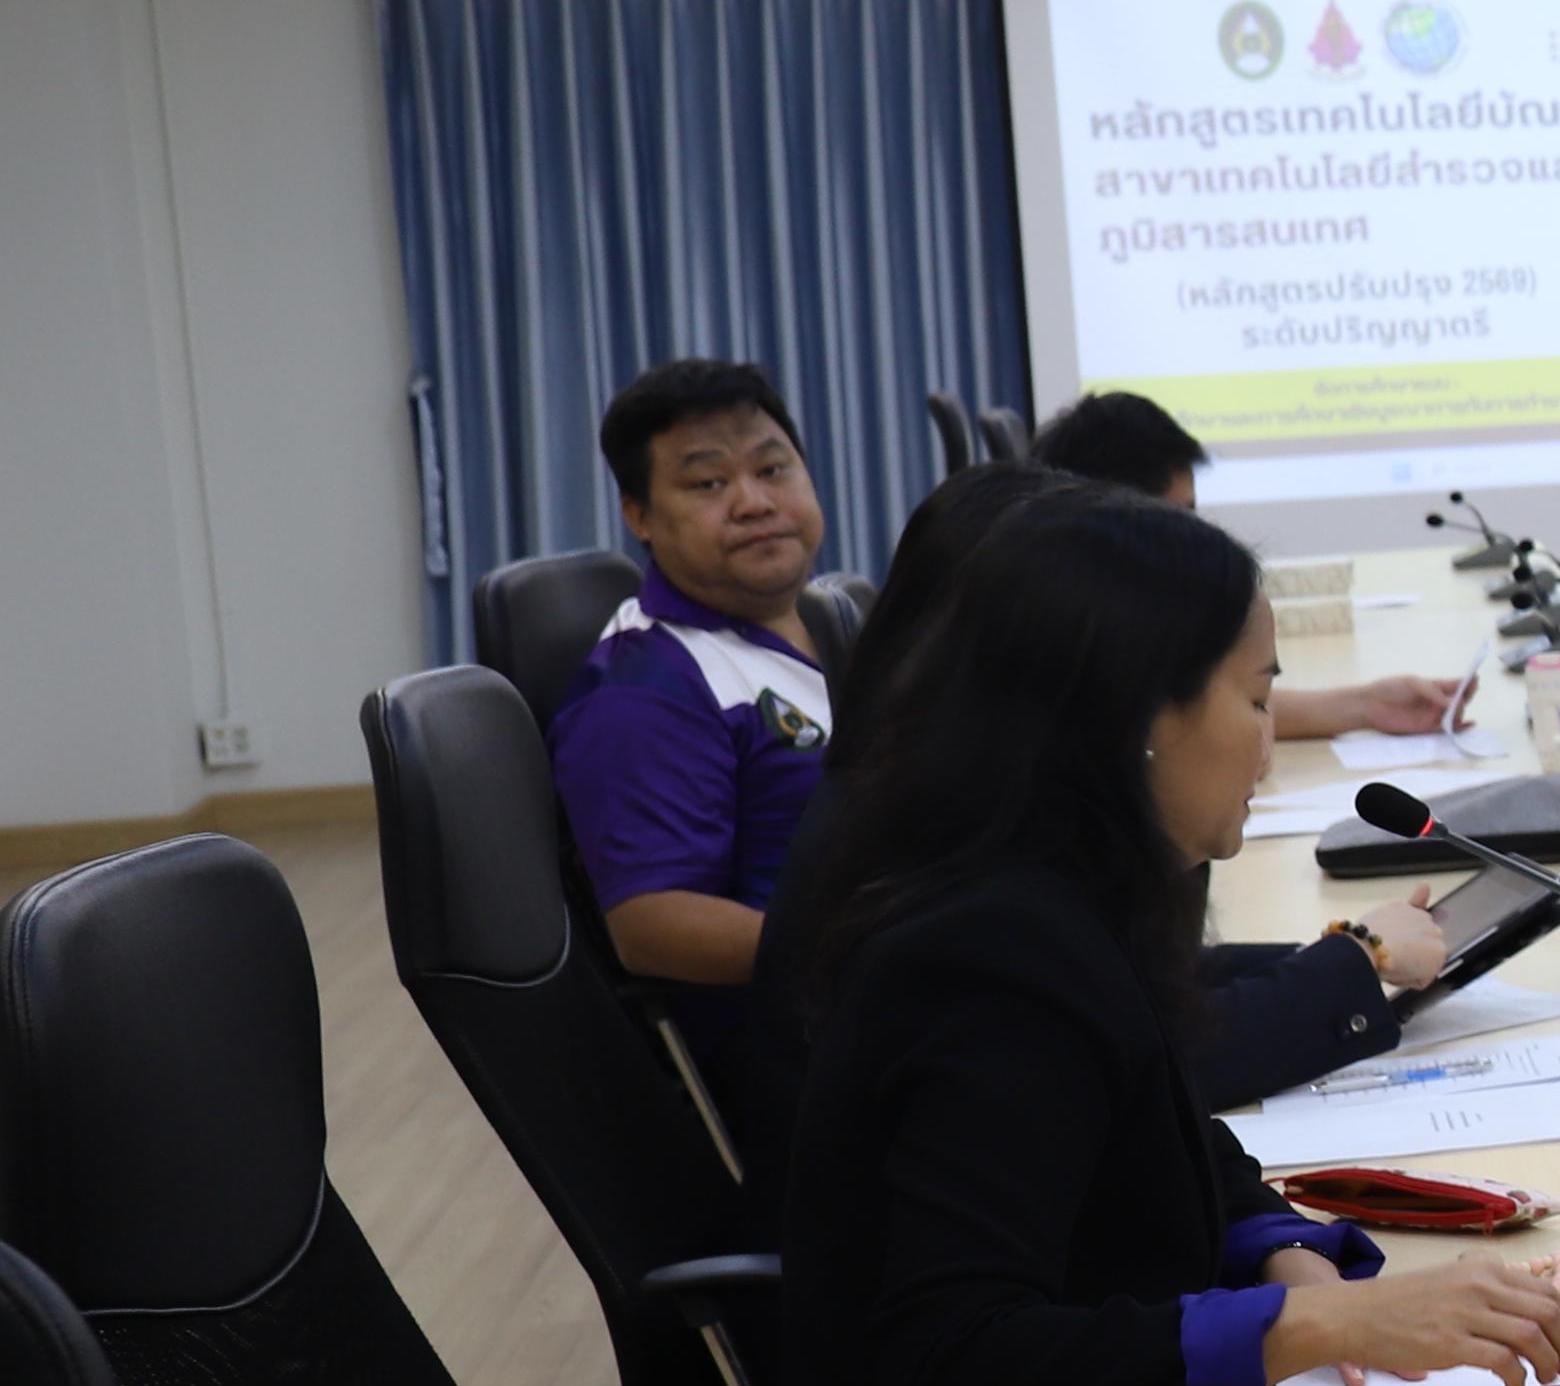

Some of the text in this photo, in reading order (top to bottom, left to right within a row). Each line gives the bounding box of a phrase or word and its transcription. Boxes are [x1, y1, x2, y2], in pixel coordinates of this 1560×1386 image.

[1100, 215, 1370, 263] ภูมิสารสนเทศ
[1177, 266, 1538, 312] (หลักสูตรปรับปรุง 2569)
[1242, 309, 1491, 349] ระดับปริญญาตรี
